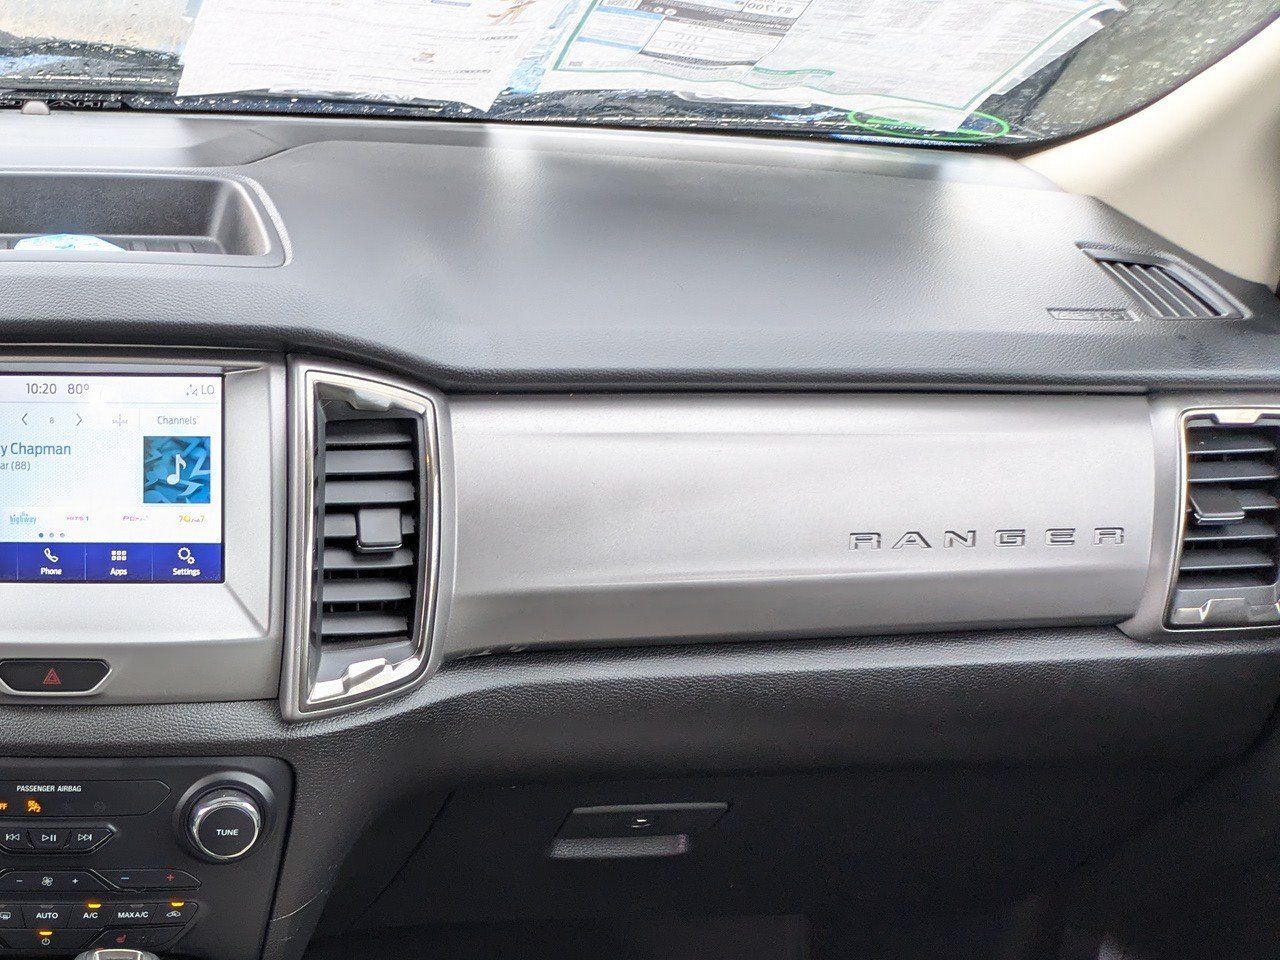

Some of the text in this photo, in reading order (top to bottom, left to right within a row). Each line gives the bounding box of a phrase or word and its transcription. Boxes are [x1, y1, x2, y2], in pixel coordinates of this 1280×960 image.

[26, 383, 57, 394] 10:20
[201, 384, 215, 395] LO
[157, 415, 197, 425] Channels
[10, 442, 71, 456] Chapman
[11, 461, 31, 471] (88)
[848, 527, 1125, 551] RANGER
[40, 567, 62, 575] Phone
[110, 568, 128, 576] Apps
[172, 567, 201, 576] Settings
[216, 828, 239, 836] TUNE
[83, 911, 99, 919] A/C
